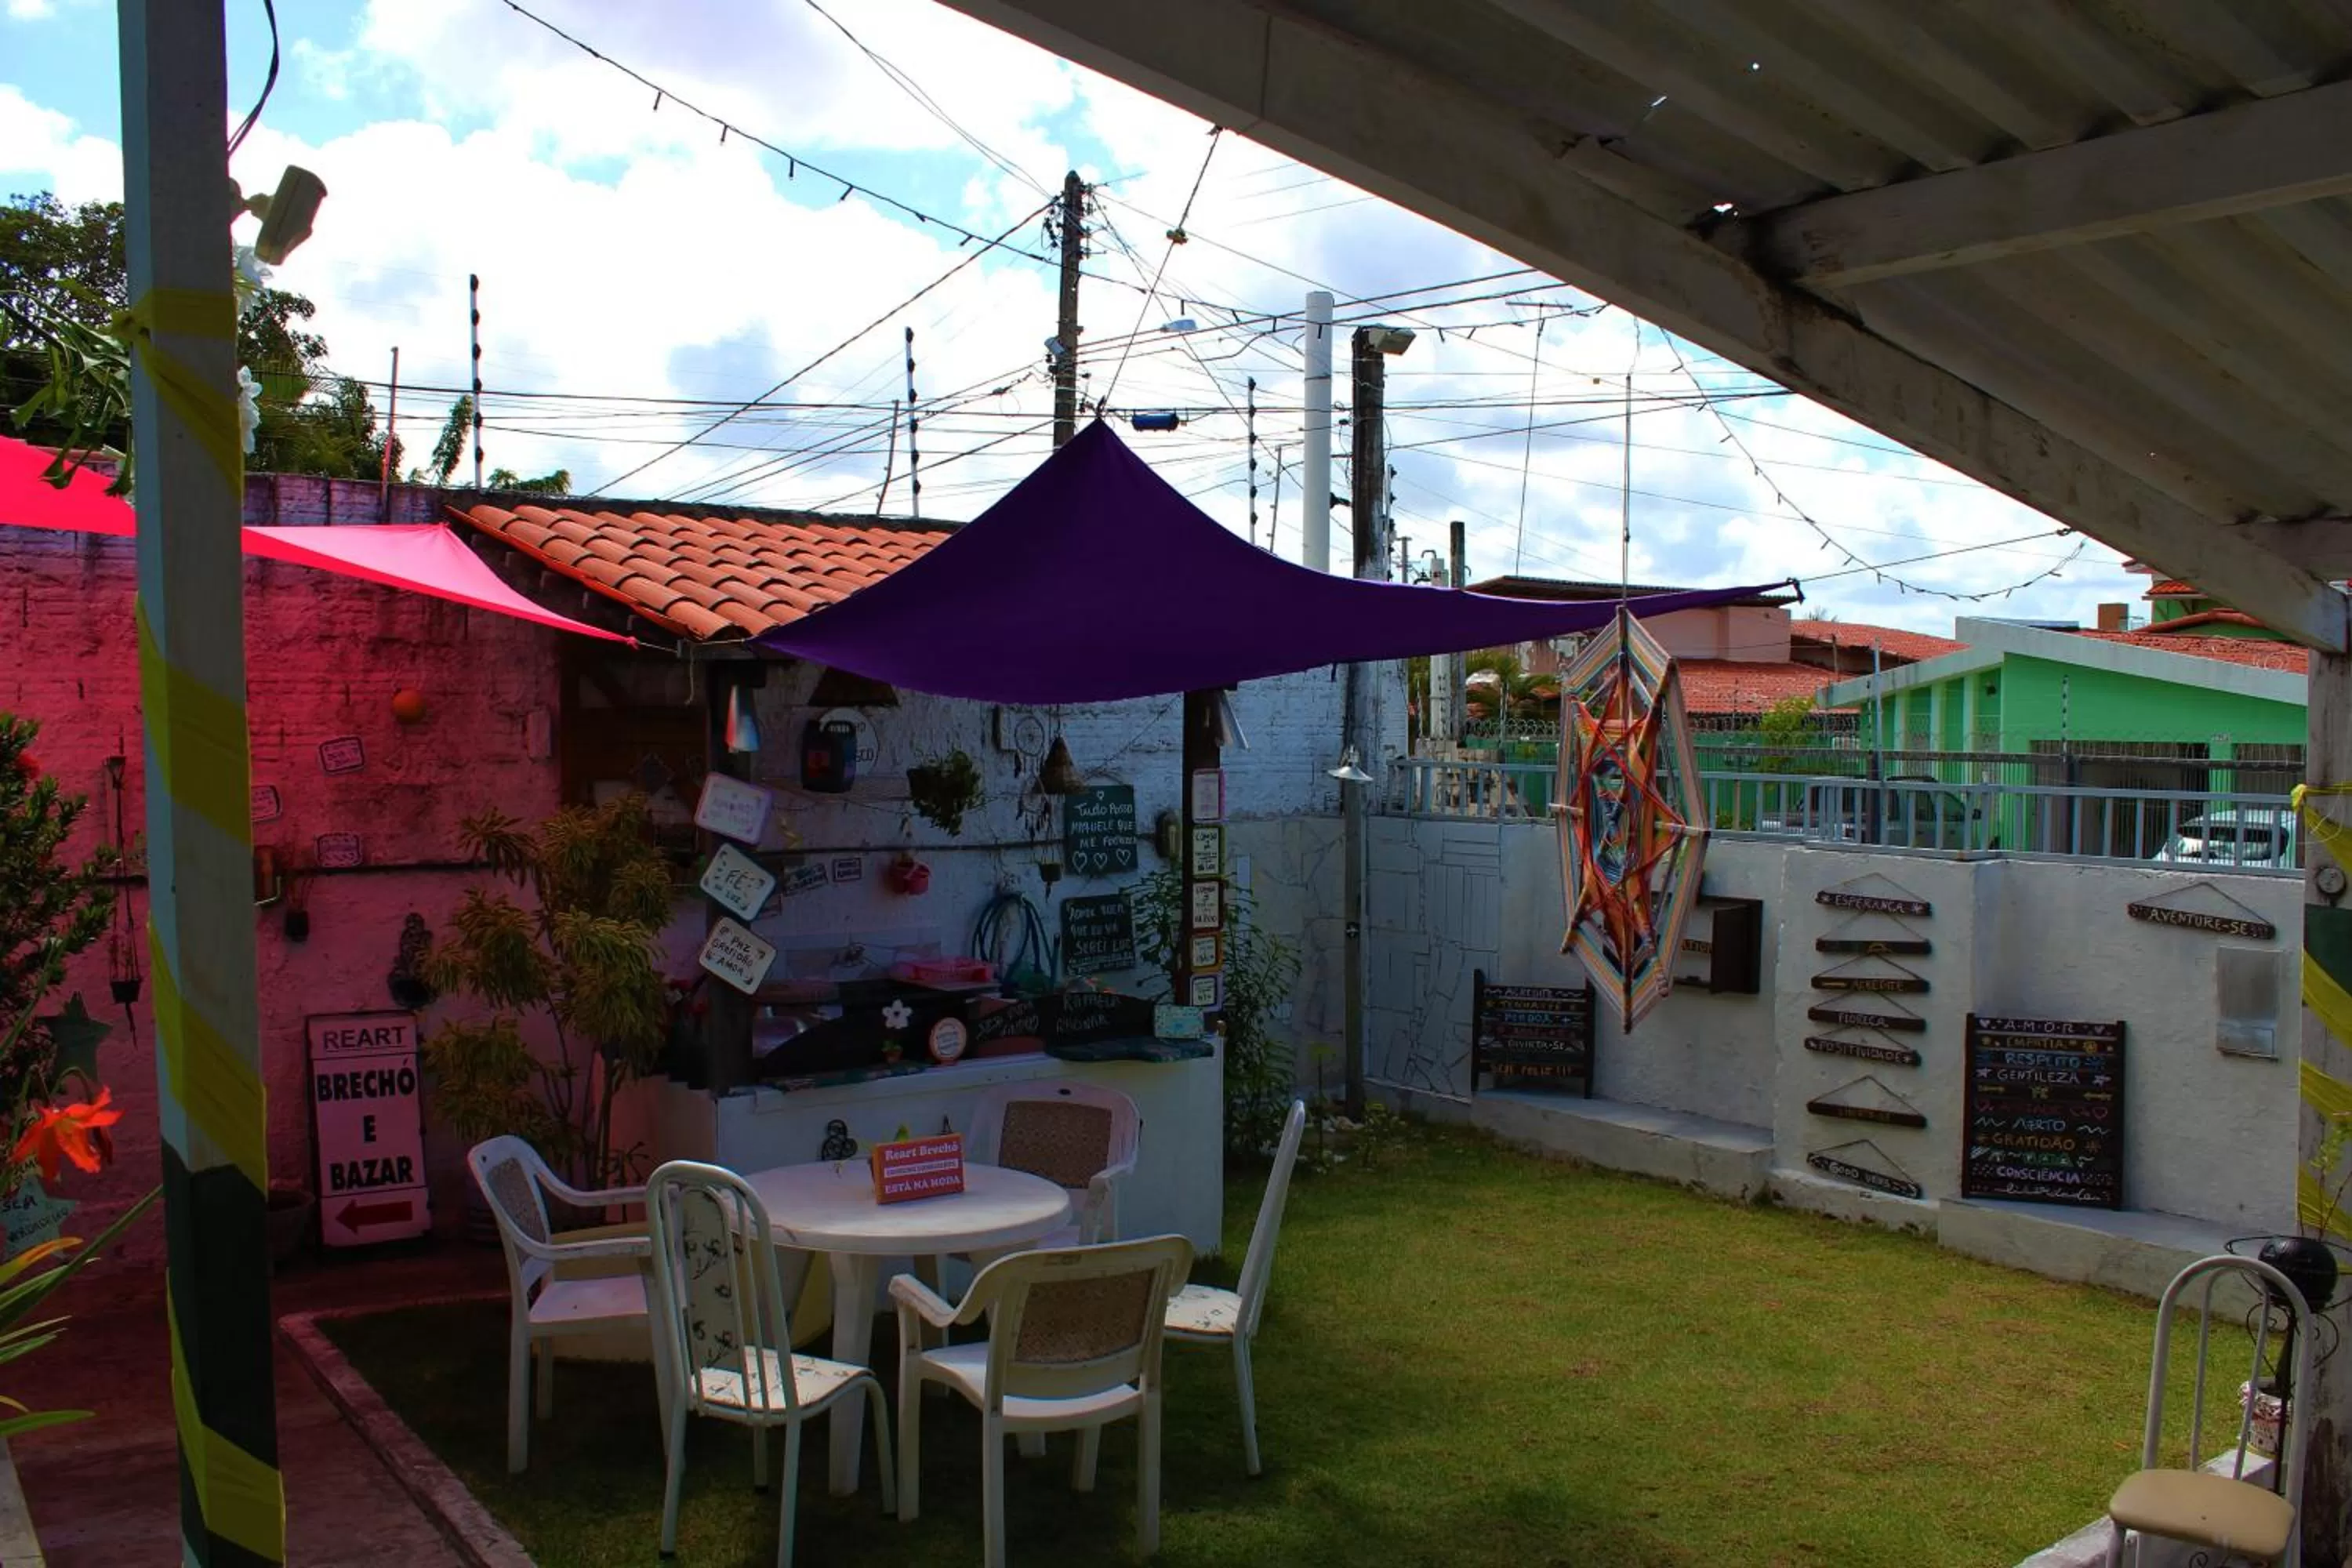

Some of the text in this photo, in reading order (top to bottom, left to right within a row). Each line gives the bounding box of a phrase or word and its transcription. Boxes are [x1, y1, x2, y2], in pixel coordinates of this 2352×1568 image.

[1073, 802, 1108, 816] Tudo
[1080, 837, 1097, 848] ME
[2149, 909, 2248, 935] AVENTURE-SE
[323, 1025, 406, 1050] REART
[317, 1058, 416, 1101] BRECHÓ
[1997, 1068, 2082, 1085] GENTILEZA
[363, 1115, 377, 1142] E
[884, 1141, 959, 1161] Reart Brechó
[329, 1156, 413, 1190] BAZAR
